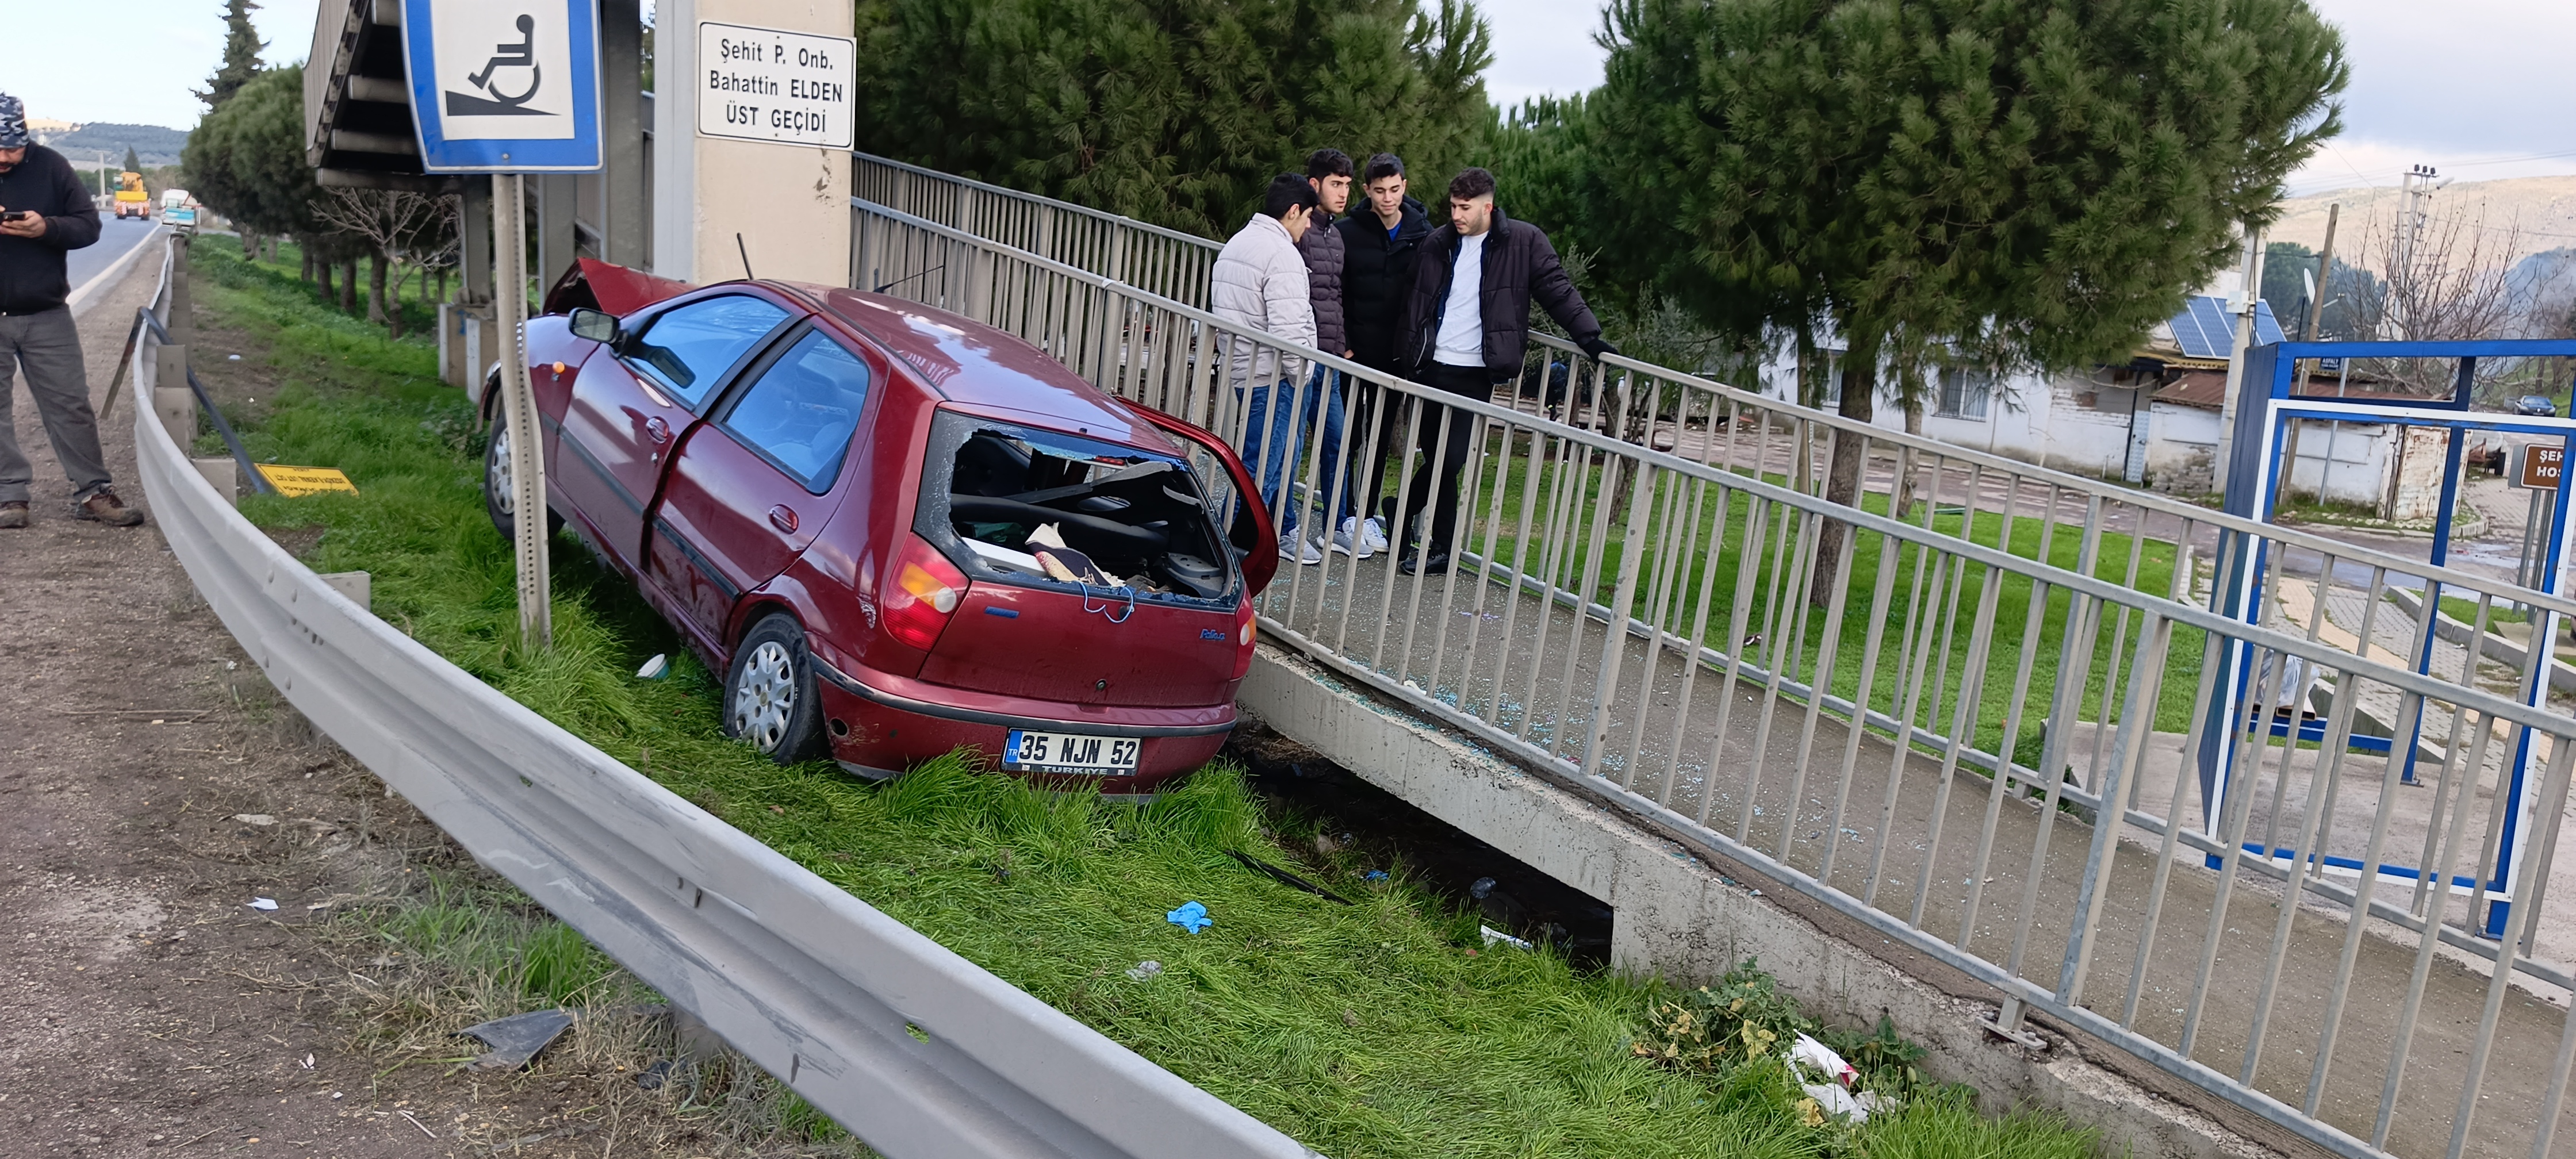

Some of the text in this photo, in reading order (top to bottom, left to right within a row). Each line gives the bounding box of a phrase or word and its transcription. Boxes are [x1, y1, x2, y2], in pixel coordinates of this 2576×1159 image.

[721, 38, 833, 70] Şehit P. Onb.
[710, 70, 842, 102] Bahattin ELDEN
[726, 100, 826, 135] ÜST GEÇİDİ
[1009, 748, 1018, 757] TR
[1019, 735, 1137, 765] 35 NJN 52
